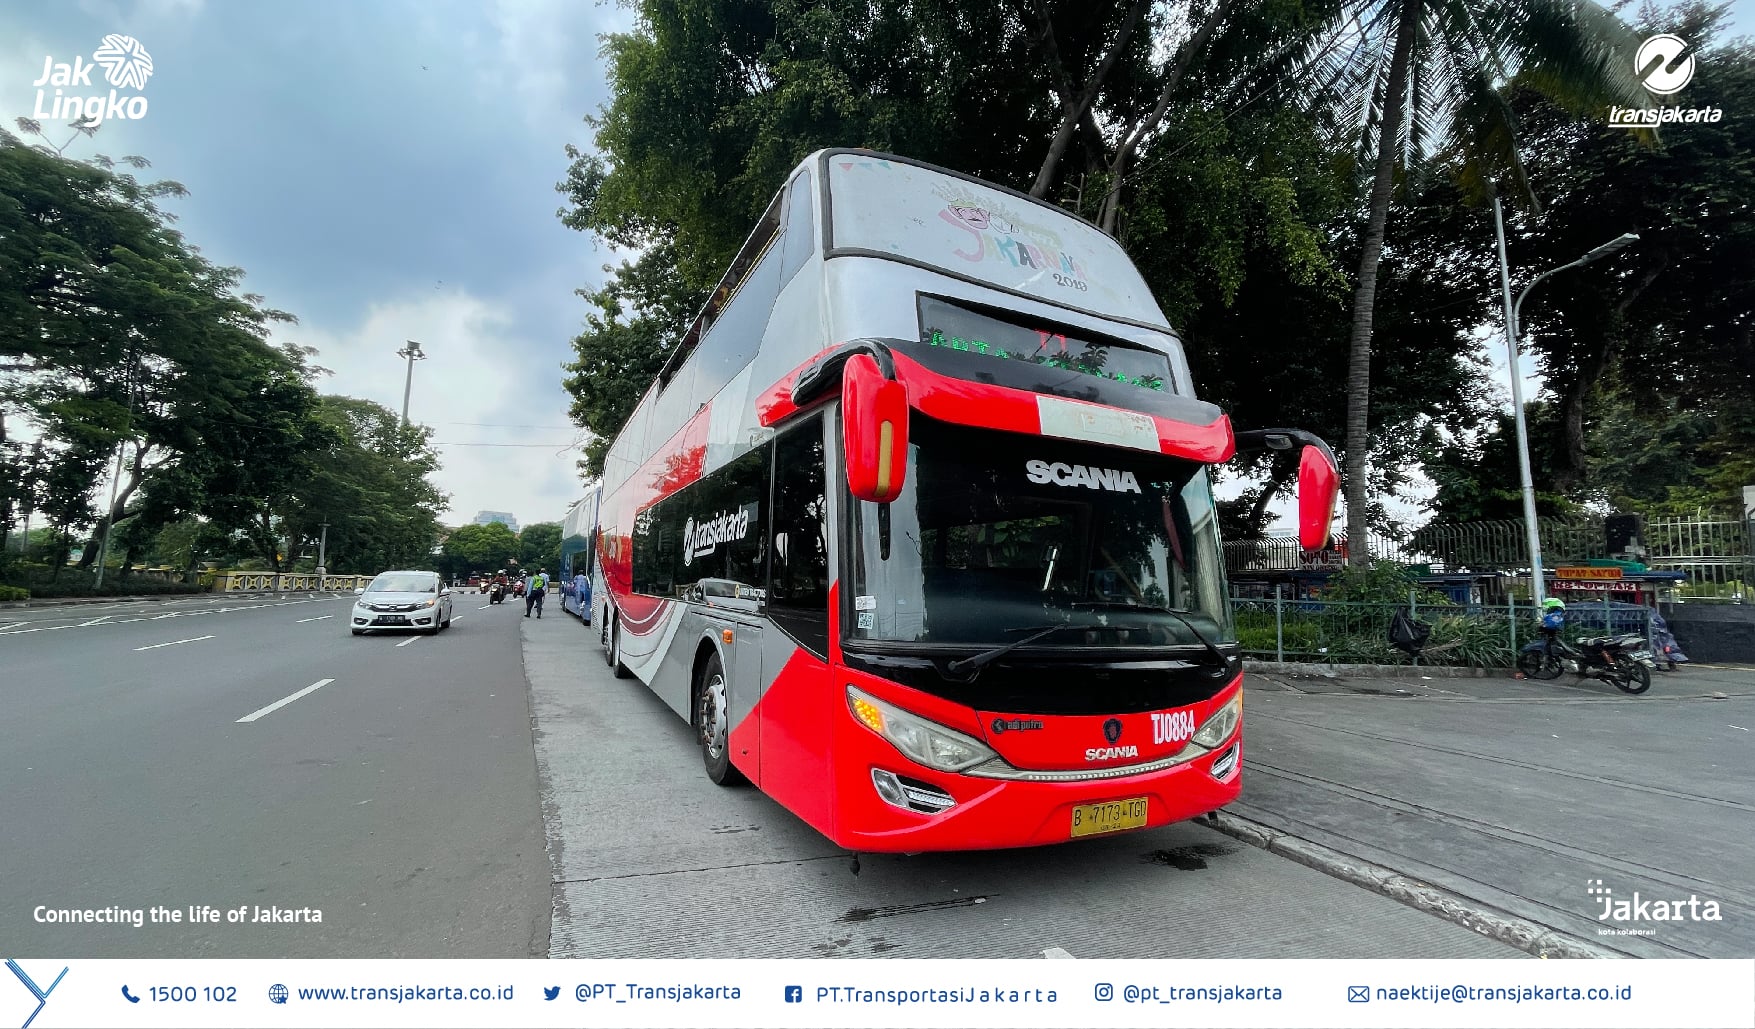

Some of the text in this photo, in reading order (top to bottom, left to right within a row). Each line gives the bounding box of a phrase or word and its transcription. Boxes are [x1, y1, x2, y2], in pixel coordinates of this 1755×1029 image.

[1026, 459, 1142, 494] SCANIA
[694, 504, 749, 558] transjakarta
[1151, 709, 1196, 745] TJ0884
[1084, 745, 1139, 761] SCANIA
[1074, 809, 1082, 826] B
[1093, 804, 1120, 823] 7173
